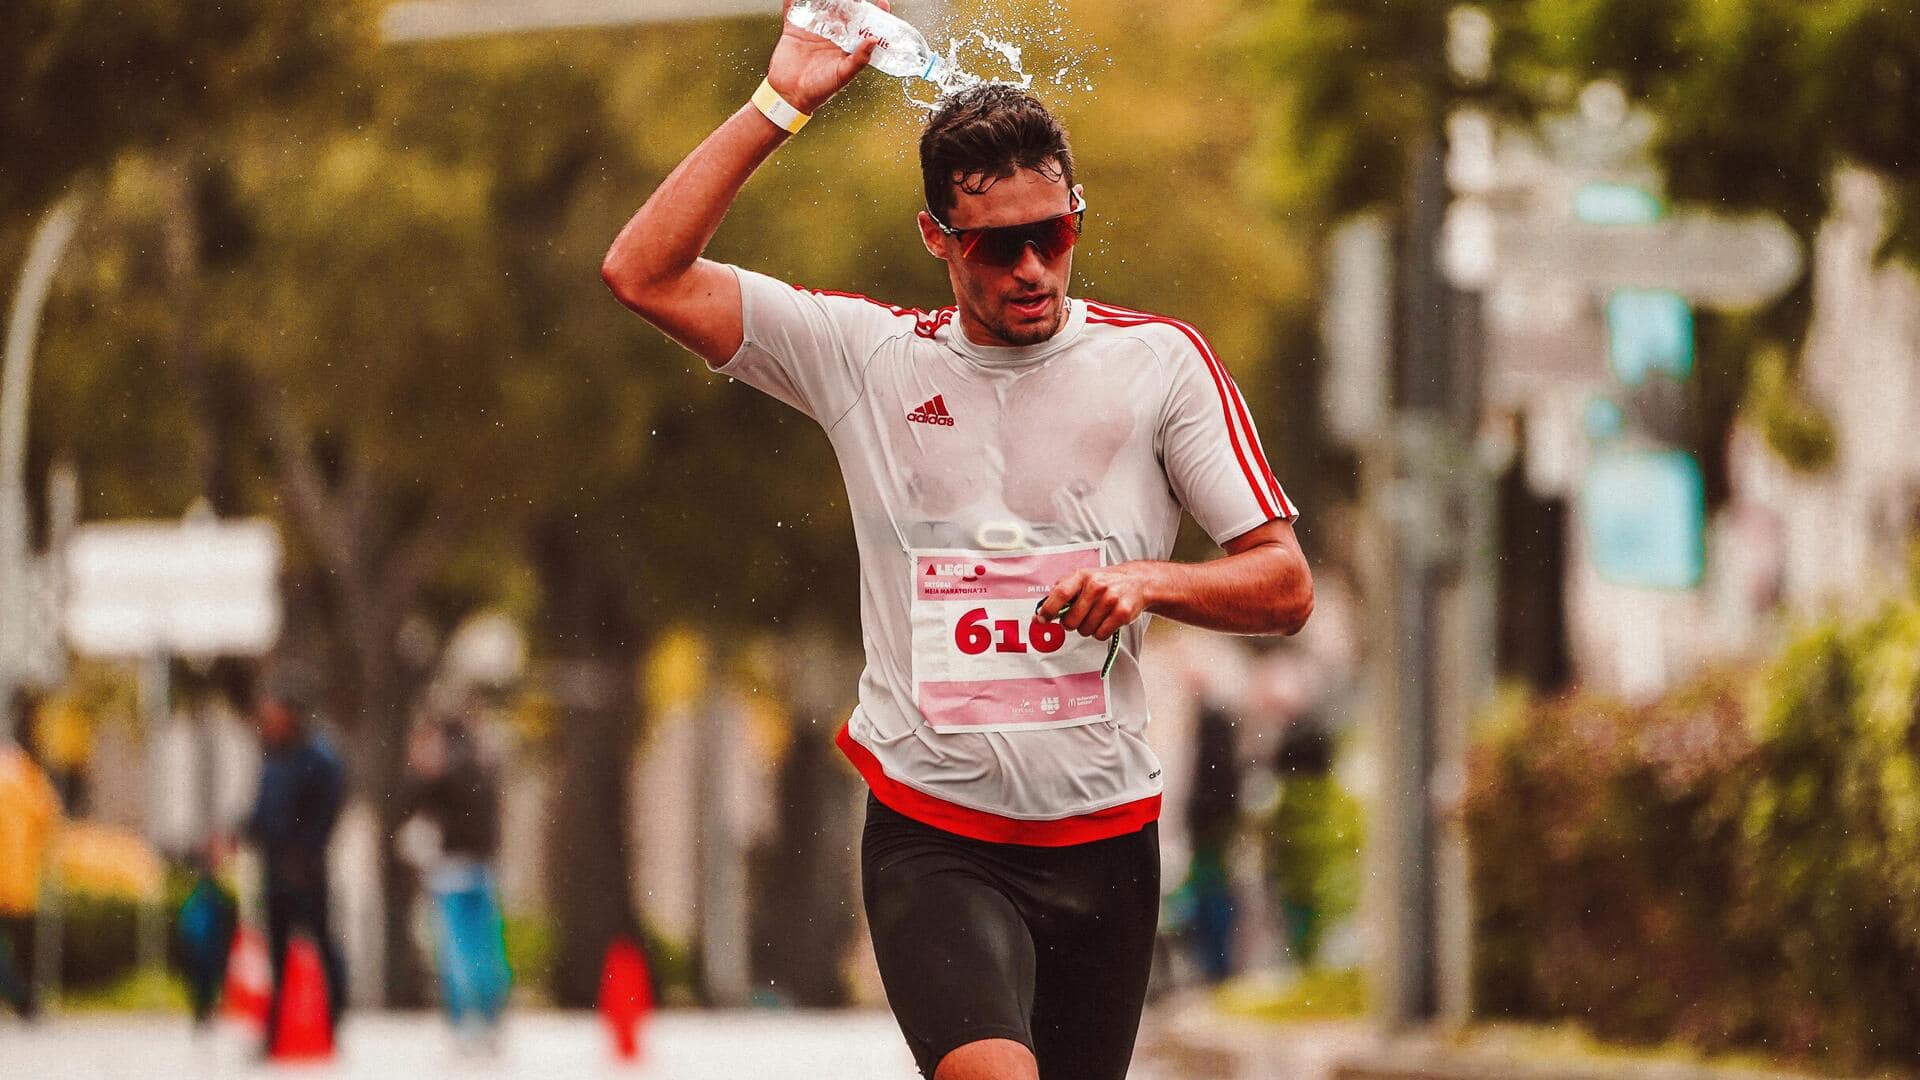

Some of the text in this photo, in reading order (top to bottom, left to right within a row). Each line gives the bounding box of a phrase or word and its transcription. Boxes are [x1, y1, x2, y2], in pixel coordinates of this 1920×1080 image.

[906, 412, 955, 427] adidas
[925, 563, 986, 579] ALEGRO
[955, 607, 1066, 655] 616
